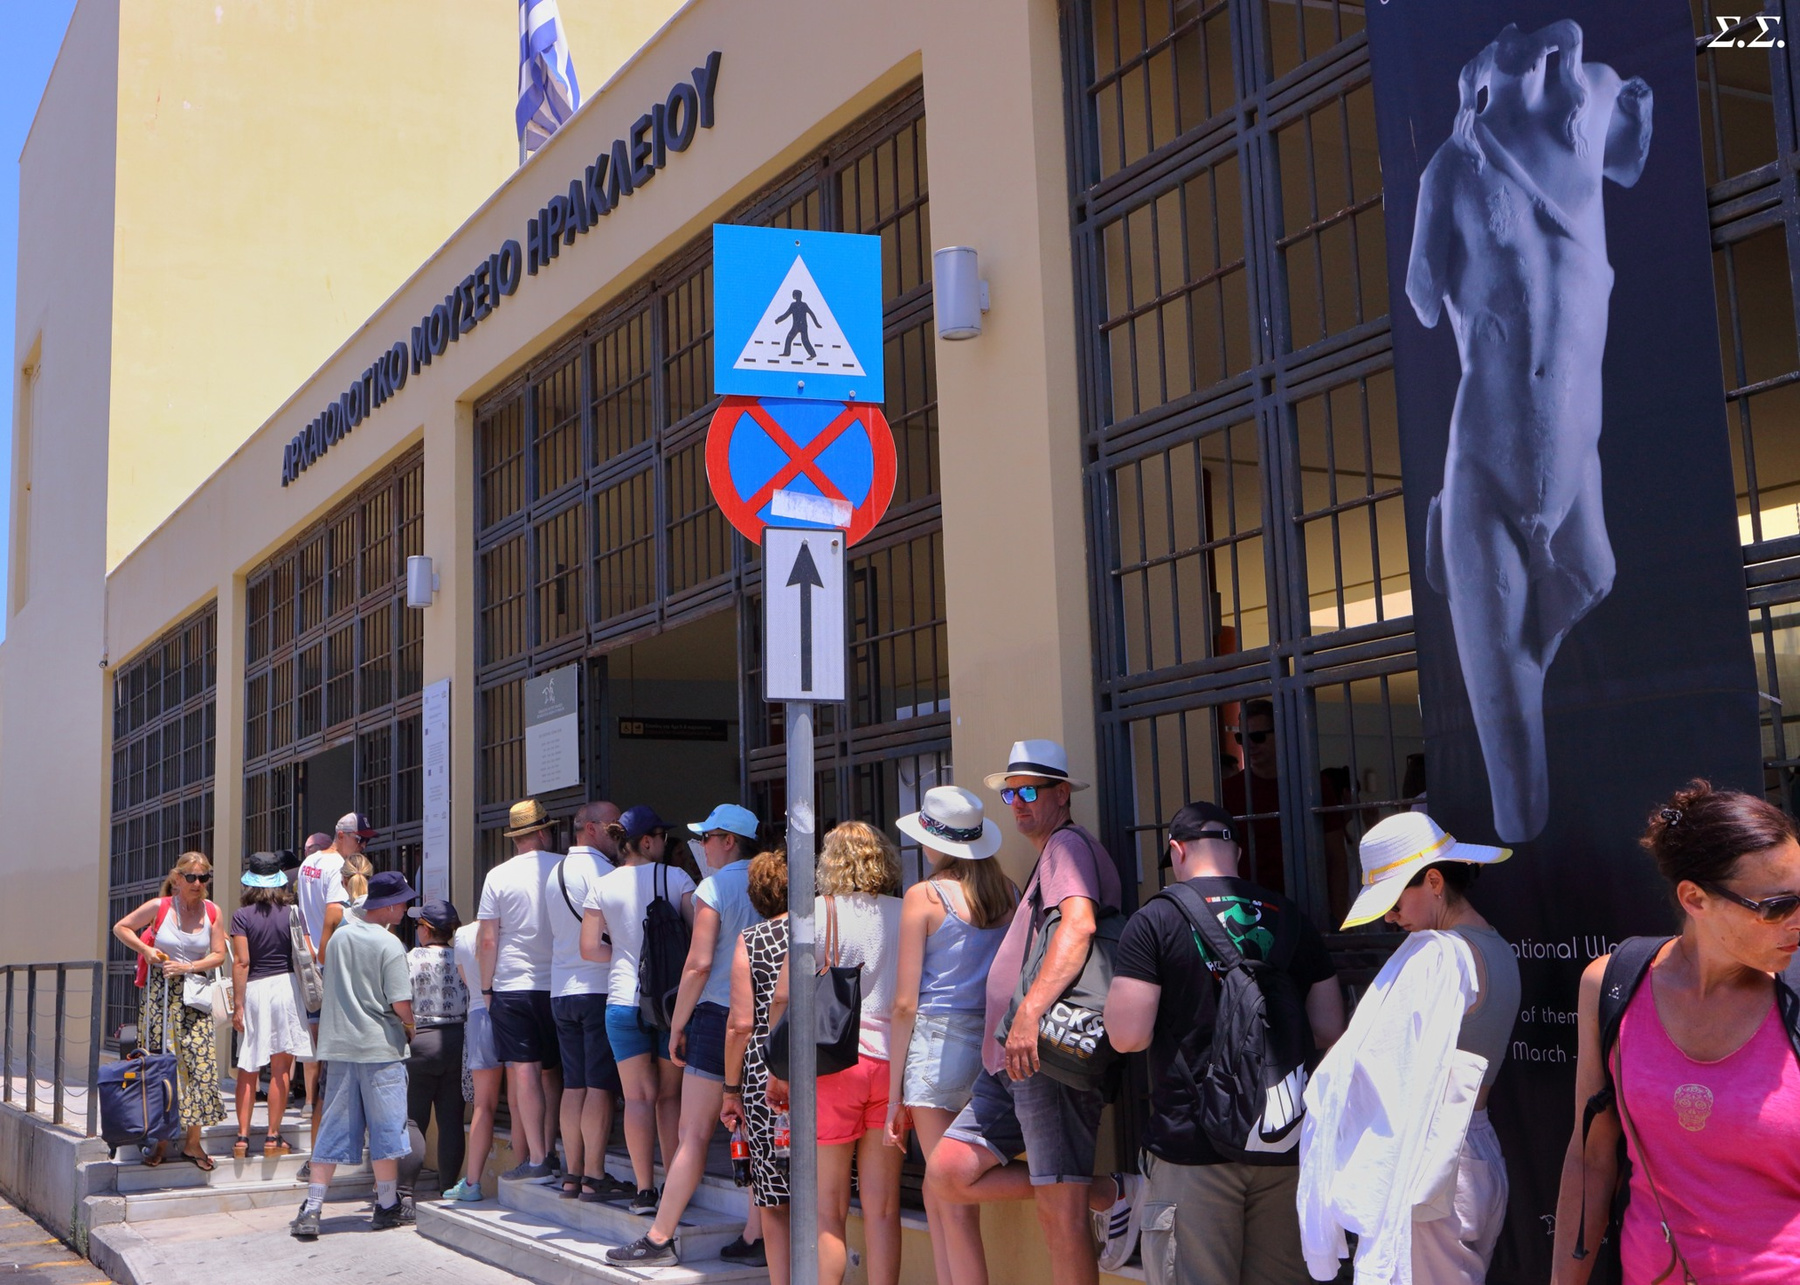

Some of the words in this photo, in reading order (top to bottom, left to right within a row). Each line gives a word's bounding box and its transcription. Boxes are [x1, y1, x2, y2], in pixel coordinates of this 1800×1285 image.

[281, 341, 408, 487] ΑΡΧΑΙΟΛΟΓΙΚΟ
[410, 239, 522, 375] ΜΟΥΣΕΙΟ
[527, 50, 722, 276] ΗΡΑΚΛΕΙΟΥ
[1044, 1002, 1104, 1038] CK&
[1521, 1005, 1536, 1022] of
[1513, 1041, 1566, 1063] March
